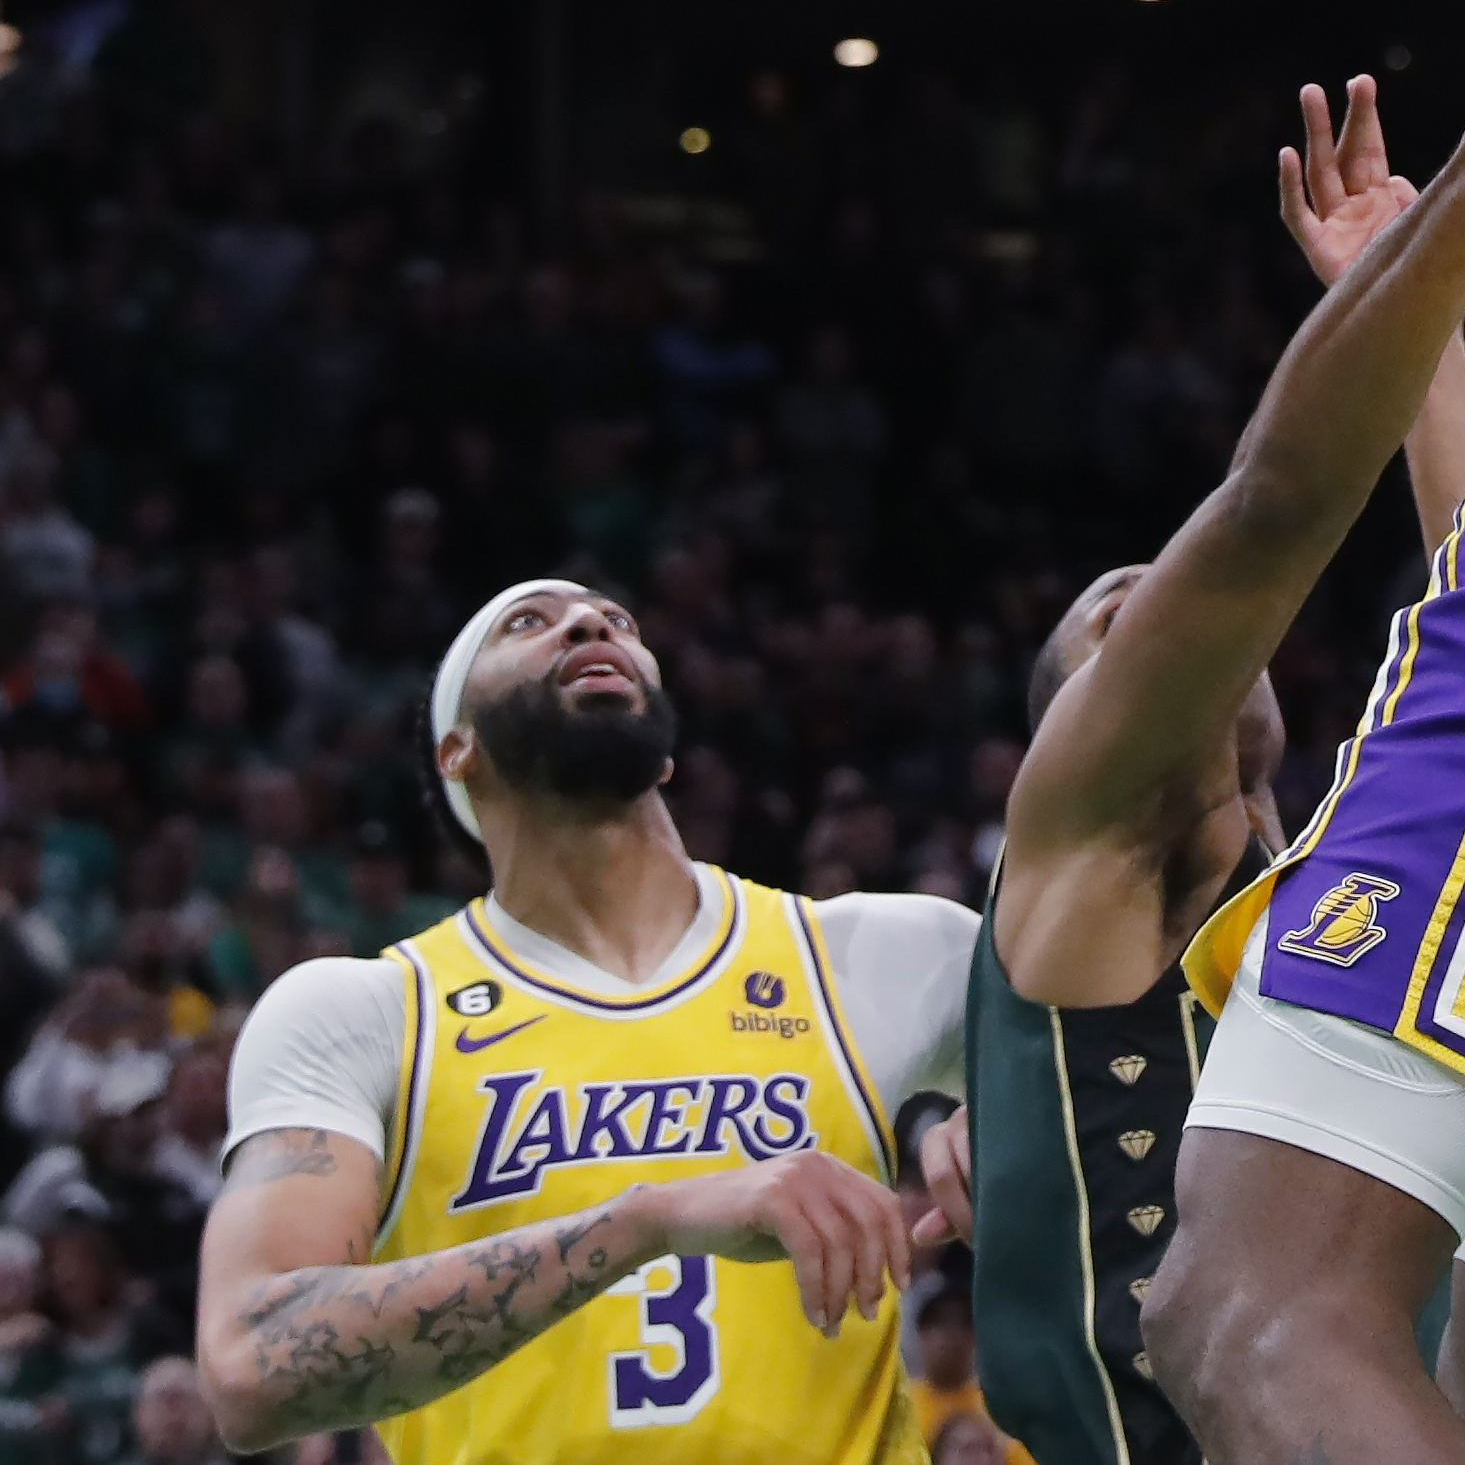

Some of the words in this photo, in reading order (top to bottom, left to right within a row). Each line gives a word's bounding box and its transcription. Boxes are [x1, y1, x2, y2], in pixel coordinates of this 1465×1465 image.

[456, 984, 494, 1016] 6
[731, 1011, 811, 1039] bibigo
[446, 1068, 820, 1215] LAKERS
[602, 1252, 722, 1430] 3
